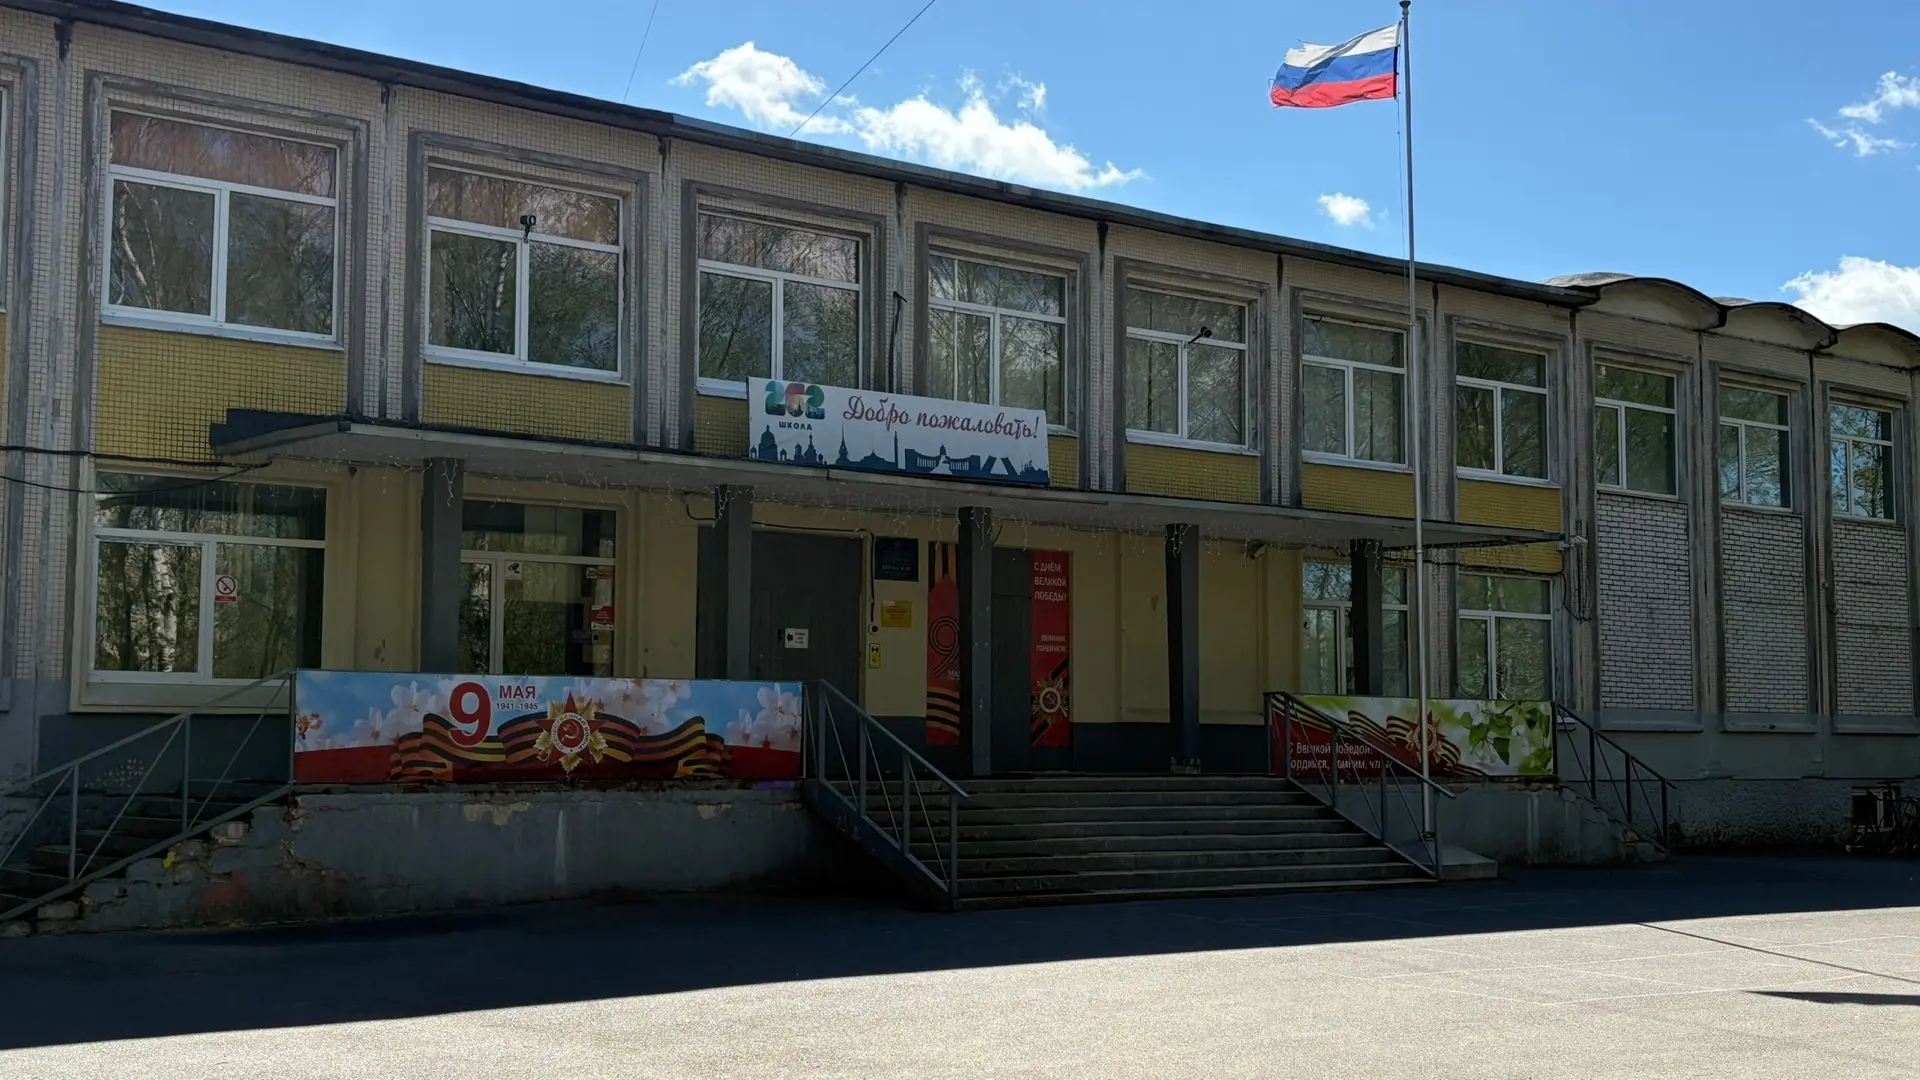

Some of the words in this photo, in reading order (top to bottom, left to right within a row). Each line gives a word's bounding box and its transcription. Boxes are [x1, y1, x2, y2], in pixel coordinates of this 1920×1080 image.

[842, 395, 910, 431] Добро
[915, 412, 1040, 439] пожаловать!
[778, 421, 813, 431] ШКОЛА
[1034, 576, 1067, 588] ВЕЛИКОЙ
[1034, 591, 1067, 602] ПОБЕДЫ!
[499, 685, 536, 699] МАЯ
[449, 682, 491, 747] 9
[1290, 760, 1330, 771] ордимся,
[1337, 760, 1367, 771] омним,
